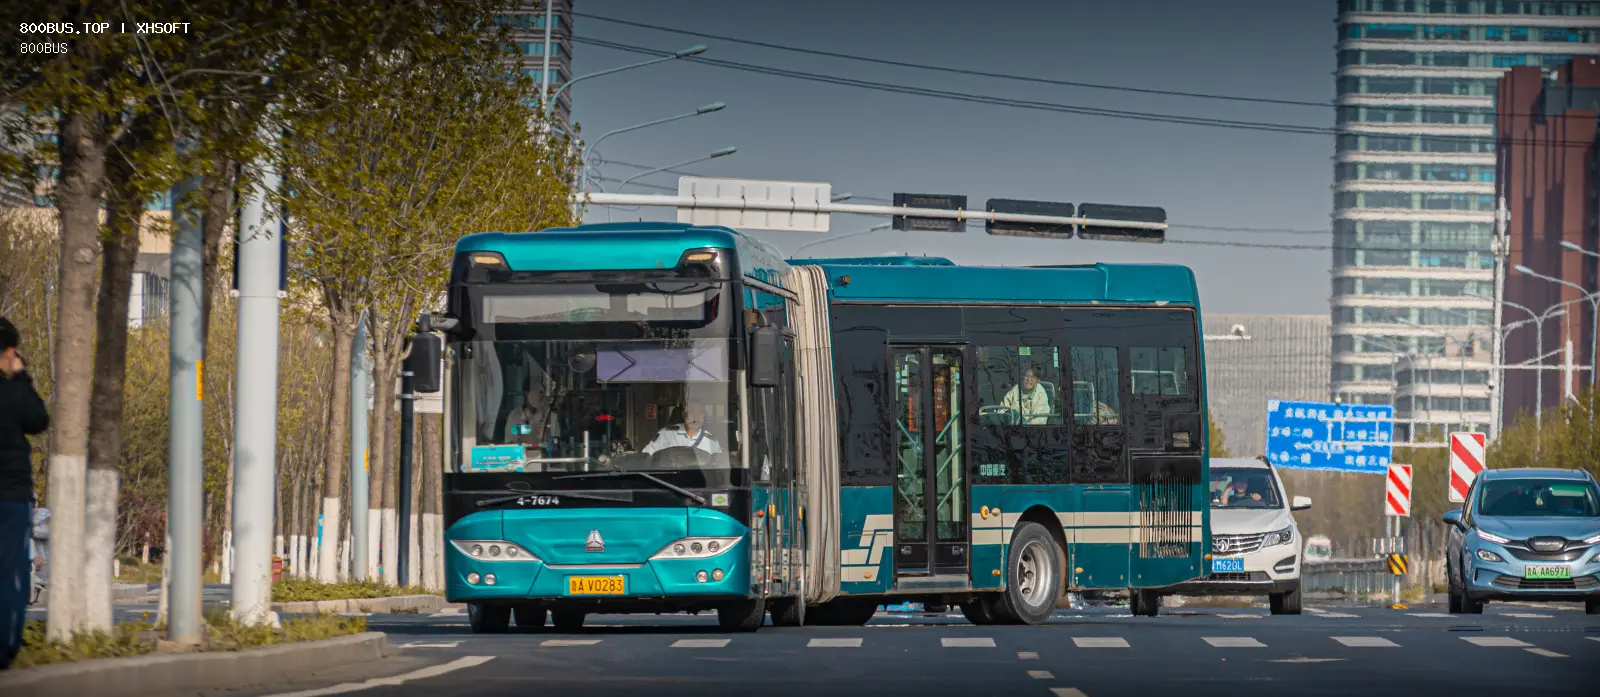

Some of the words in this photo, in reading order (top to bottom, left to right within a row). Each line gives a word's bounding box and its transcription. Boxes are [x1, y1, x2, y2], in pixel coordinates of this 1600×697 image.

[980, 463, 1006, 477] 中国重汽
[516, 495, 560, 506] 4-7674
